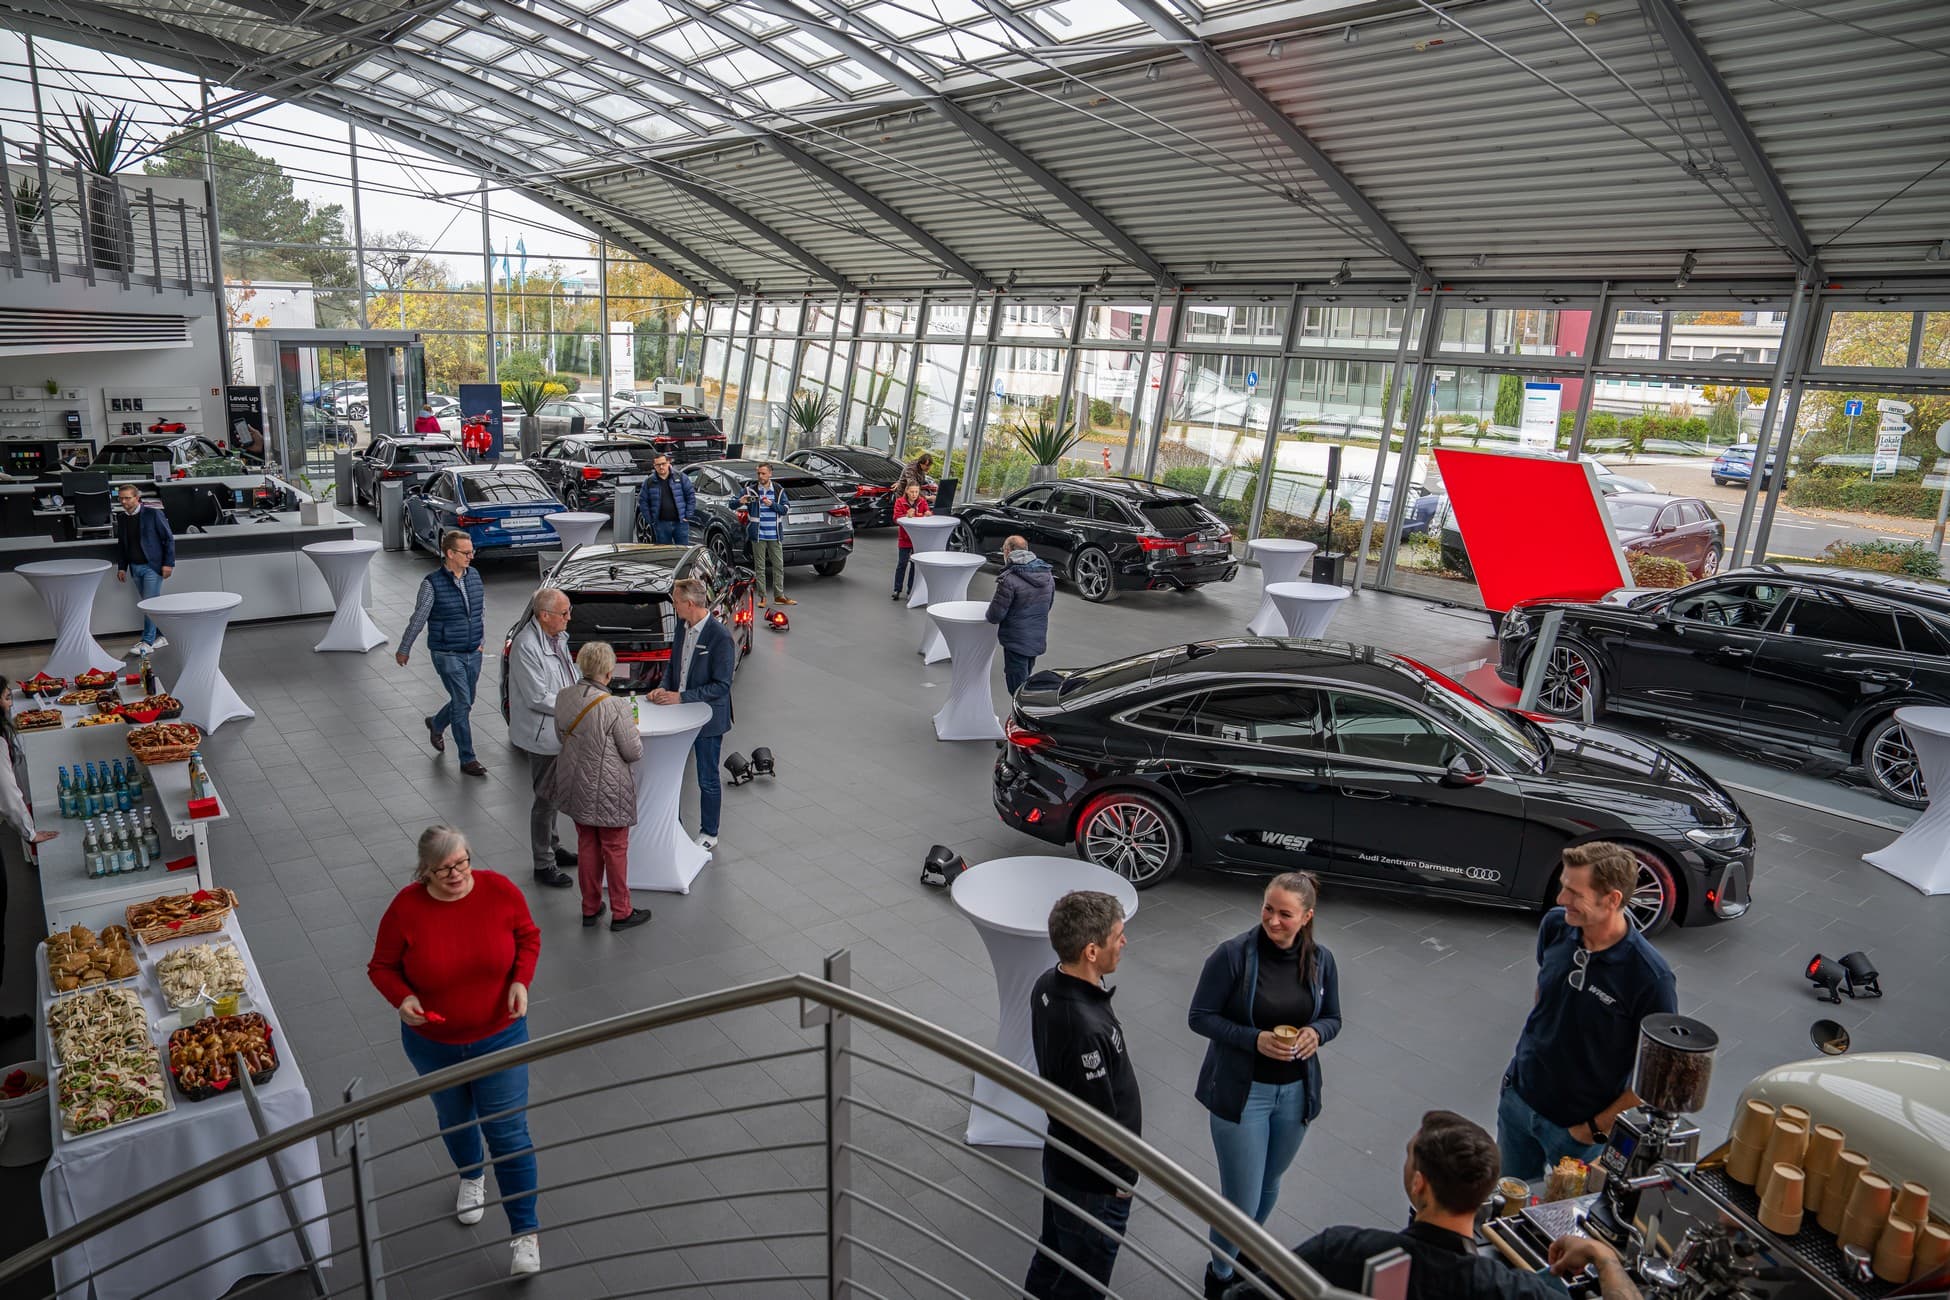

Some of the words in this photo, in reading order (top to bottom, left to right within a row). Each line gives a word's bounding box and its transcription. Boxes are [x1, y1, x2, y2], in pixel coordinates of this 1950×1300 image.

[1262, 831, 1314, 849] WIEST
[1359, 853, 1379, 862] Audi
[1380, 856, 1417, 868] Zentrum
[1418, 861, 1464, 874] Darmstadt
